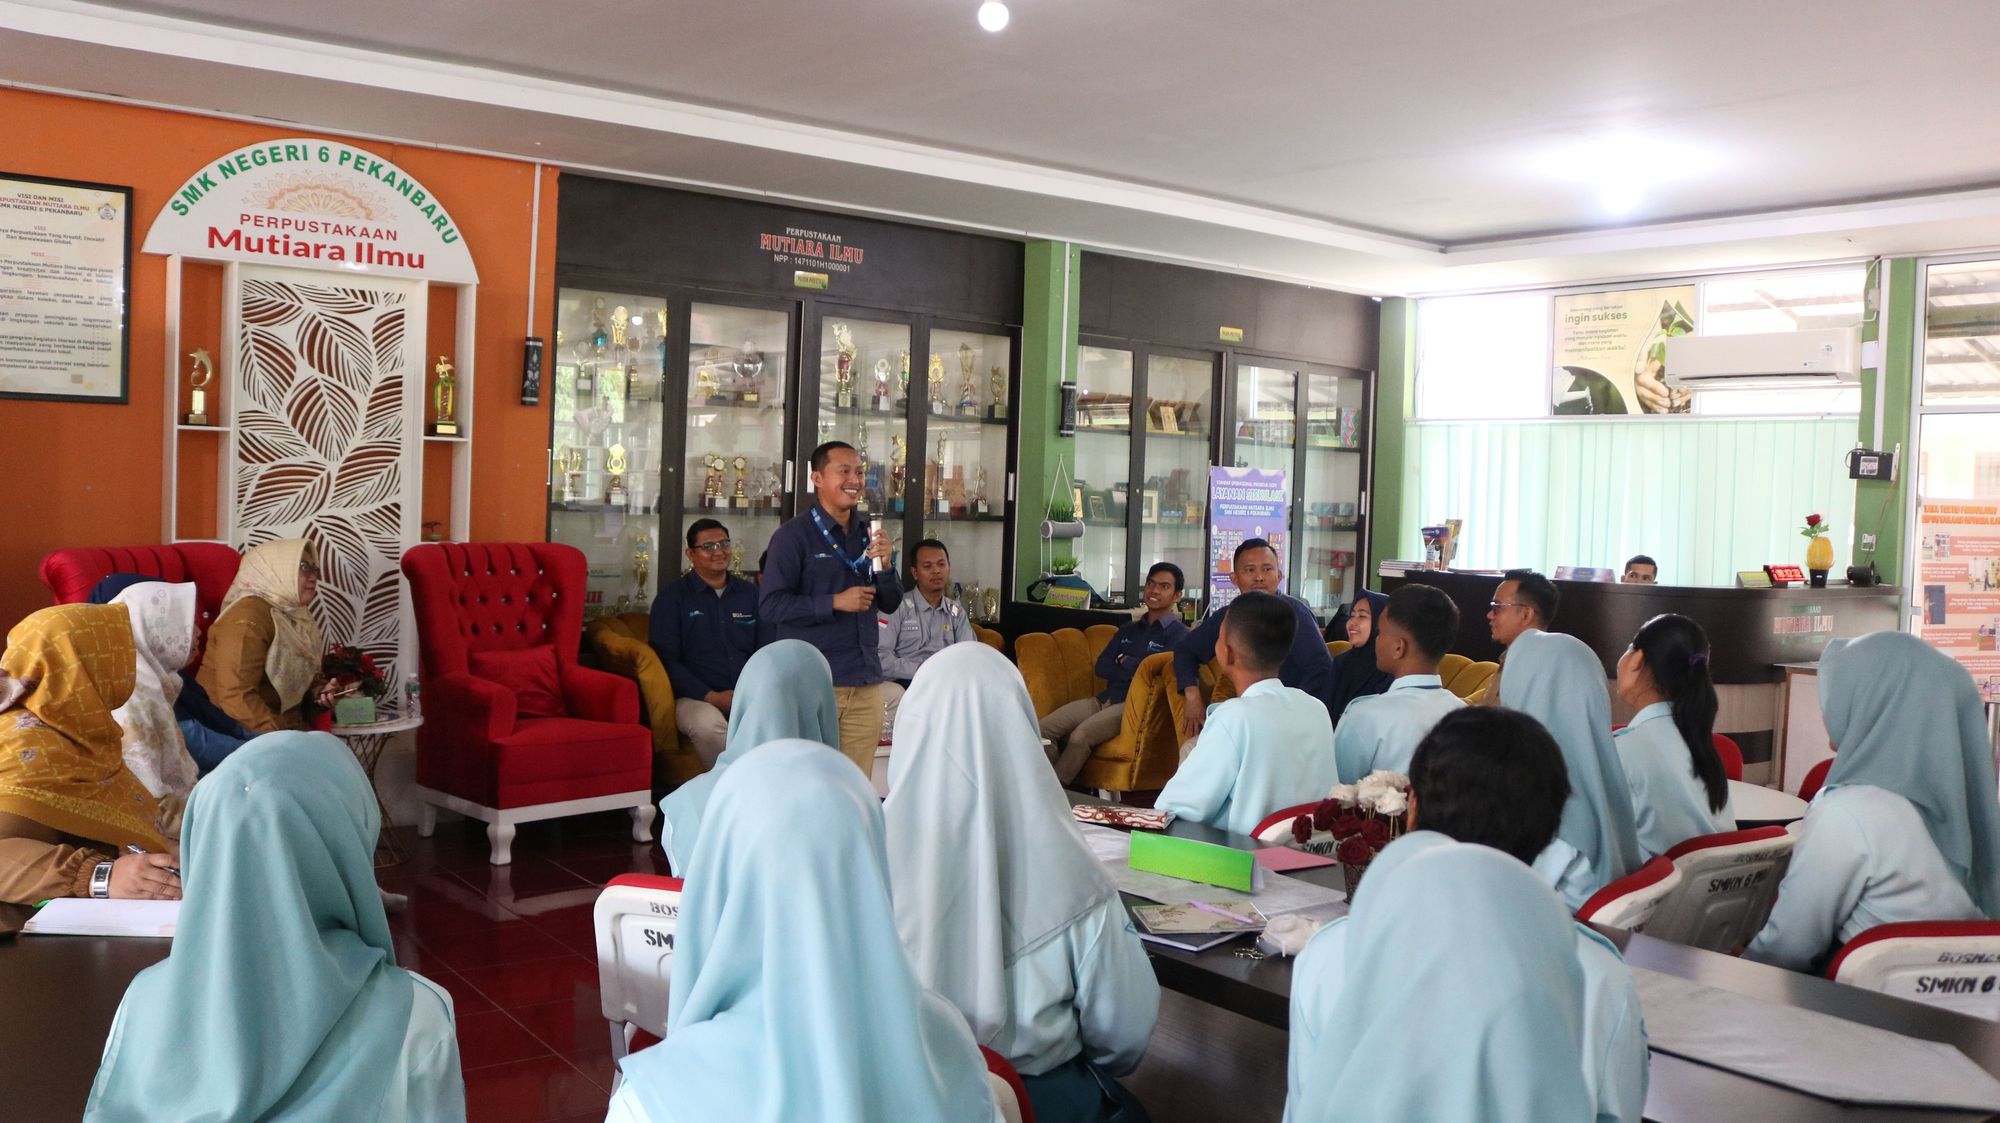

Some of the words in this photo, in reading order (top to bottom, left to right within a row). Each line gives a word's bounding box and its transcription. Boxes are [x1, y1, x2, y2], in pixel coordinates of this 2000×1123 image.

[171, 172, 218, 217] SMK
[217, 144, 308, 179] NEGERI
[317, 146, 330, 163] 6
[338, 149, 459, 244] PEKANBARU
[42, 201, 72, 209] MUTIARA
[44, 208, 83, 216] PEKANBARU
[239, 213, 398, 241] PERPUSTAKAAN
[786, 227, 842, 243] PERPUSTAKAAN
[207, 226, 346, 261] Mutiara
[355, 241, 425, 269] Ilmu
[760, 233, 824, 258] MUTIARA
[829, 243, 864, 264] ILMU
[773, 254, 789, 264] NPP
[1565, 313, 1590, 325] ingin
[1592, 312, 1628, 321] sukses
[1211, 486, 1246, 501] LAYANAN
[649, 901, 678, 917] BOS
[644, 928, 675, 951] SM
[1915, 976, 1978, 993] SMKN
[1981, 974, 1997, 994] 6
